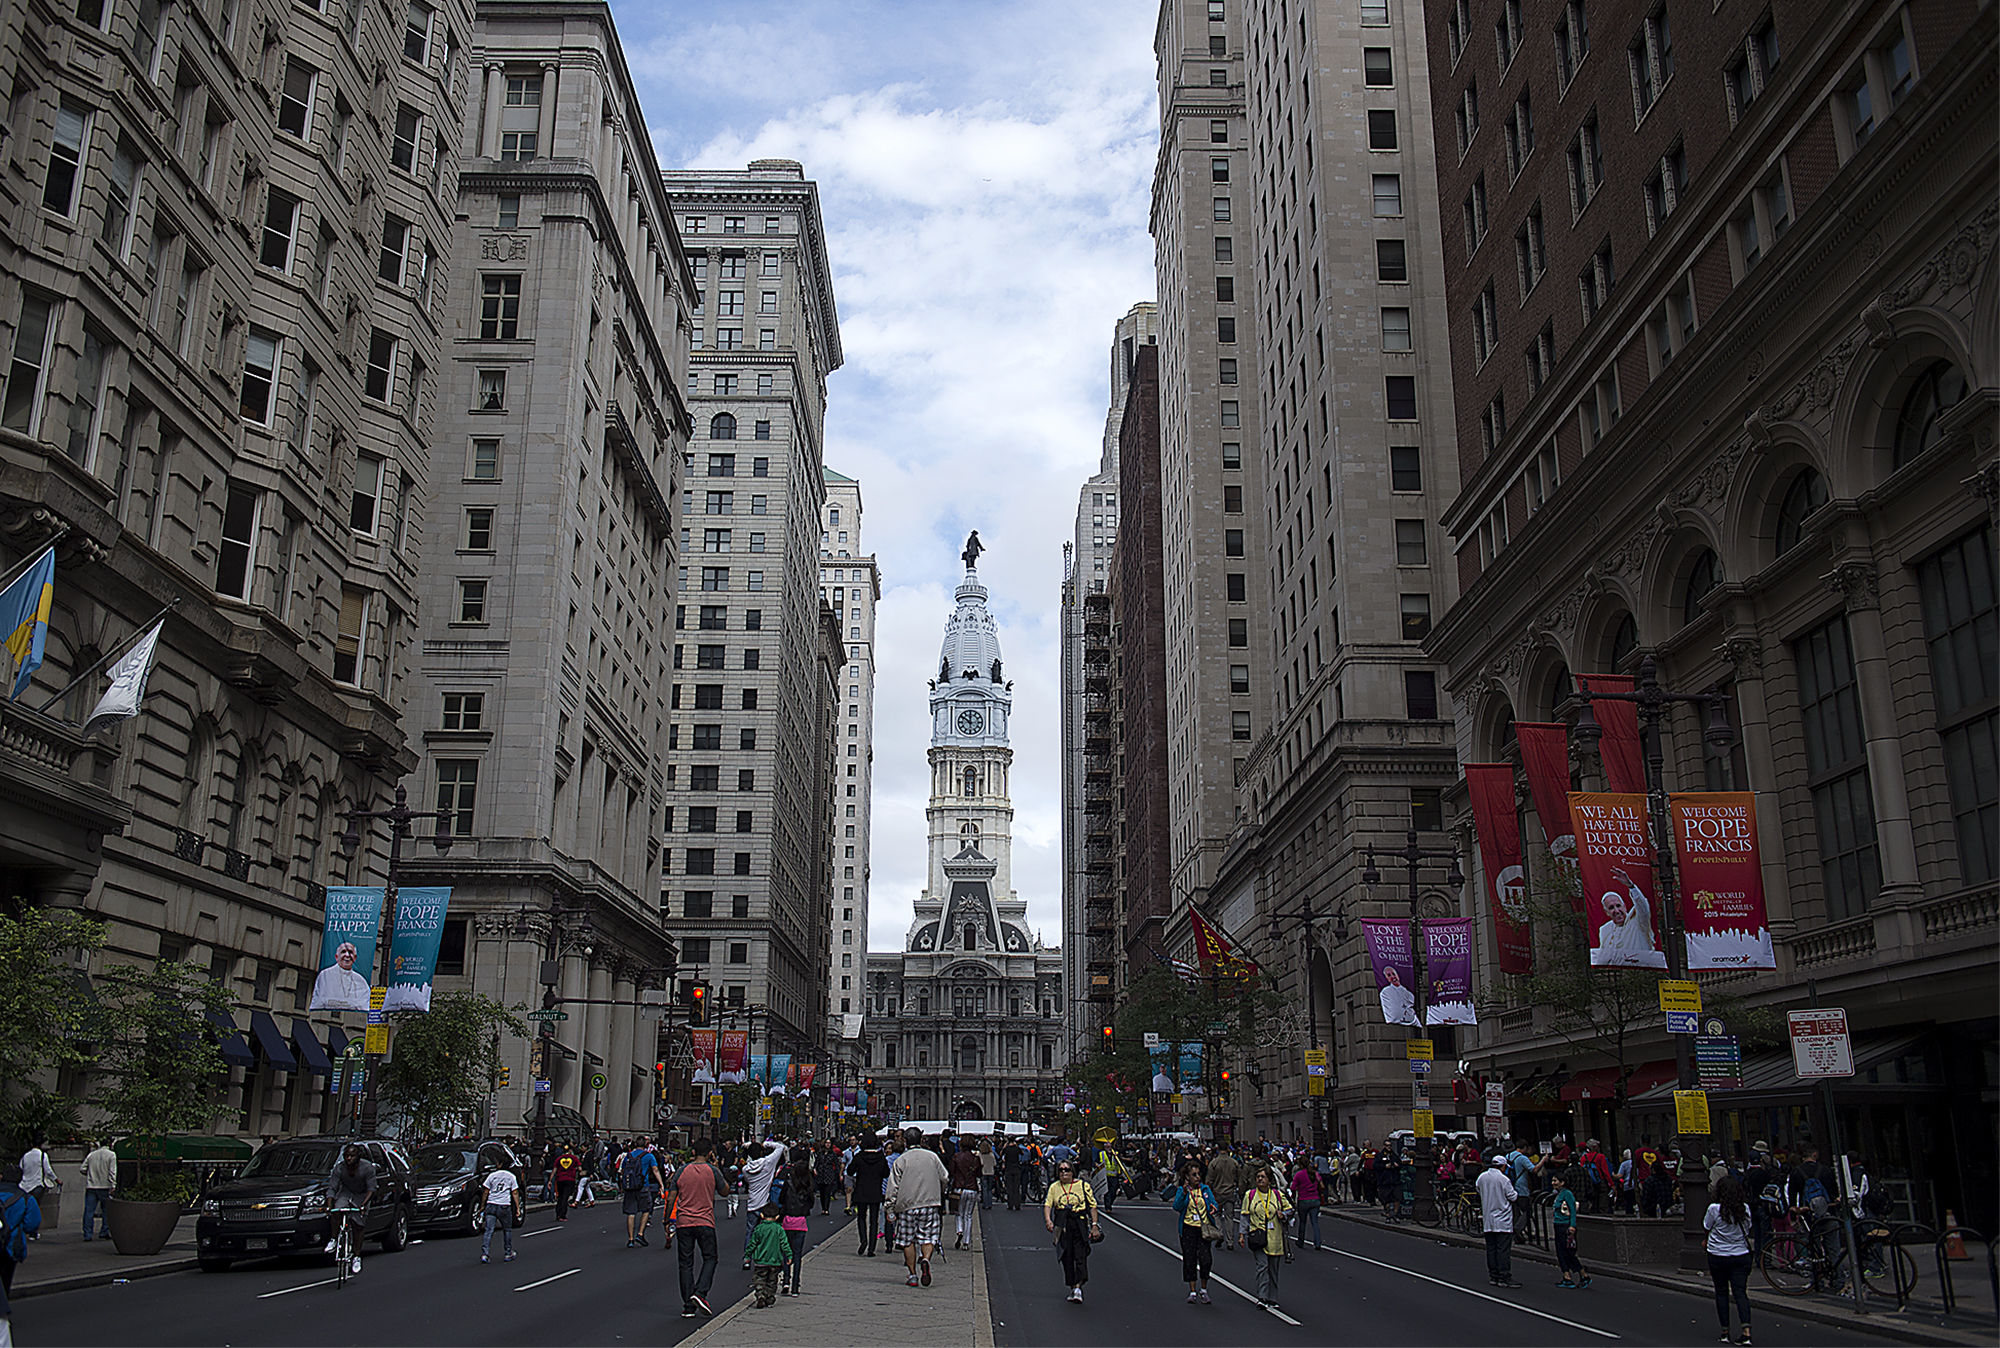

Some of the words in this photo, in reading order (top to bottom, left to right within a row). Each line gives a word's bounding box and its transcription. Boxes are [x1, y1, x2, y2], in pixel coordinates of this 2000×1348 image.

[1610, 806, 1639, 820] ALL
[1681, 806, 1748, 818] WELCOME
[1583, 819, 1616, 831] HAVE
[1616, 820, 1641, 832] THE
[1682, 818, 1751, 838] POPE
[1585, 832, 1622, 844] DUTY
[1624, 833, 1643, 846] TO
[1587, 844, 1607, 856] DO
[1685, 839, 1753, 852] FRANCIS
[358, 896, 375, 904] THE
[402, 896, 442, 905] WELCOME
[1714, 892, 1746, 900] WORLD
[330, 904, 374, 912] COURAGE
[399, 905, 440, 920] POPE
[1704, 910, 1719, 918] 2015
[396, 920, 438, 930] FRANCIS
[1428, 926, 1467, 934] WELCOME
[1384, 936, 1407, 946] THE
[1429, 933, 1468, 947] POPE
[1430, 946, 1469, 956] FRANCIS
